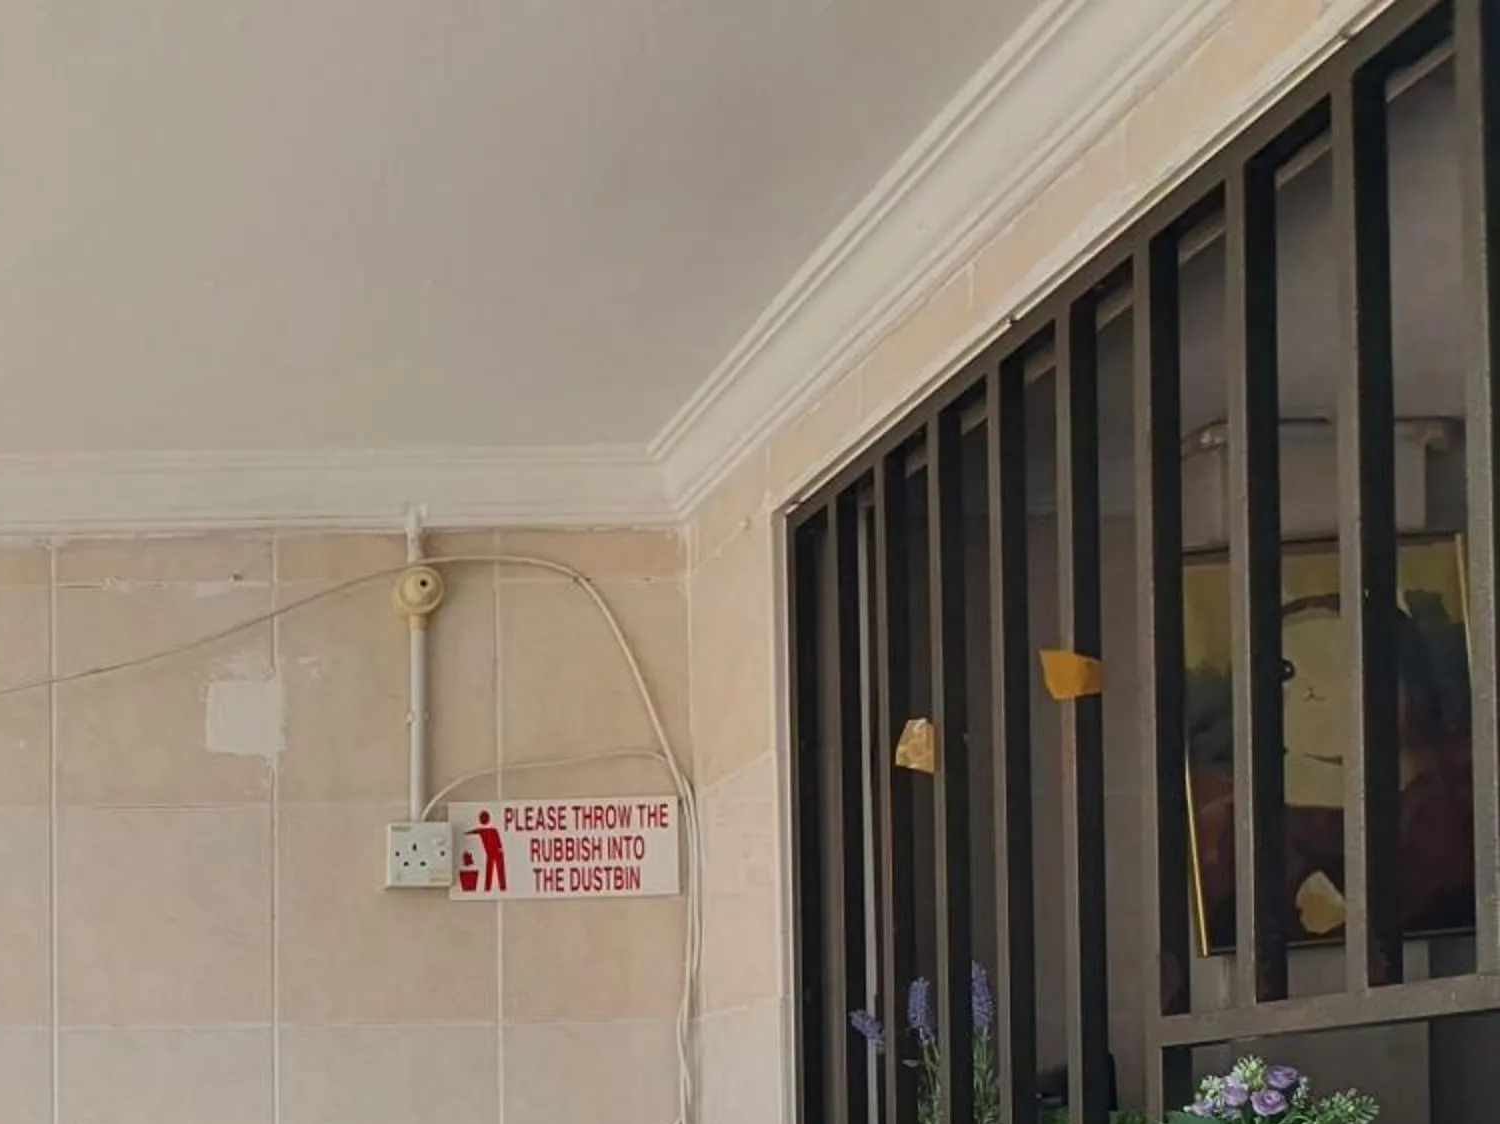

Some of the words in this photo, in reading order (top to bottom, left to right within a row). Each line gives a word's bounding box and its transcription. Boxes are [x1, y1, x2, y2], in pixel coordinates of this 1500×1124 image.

[504, 806, 567, 831] PLEASE
[573, 804, 634, 830] THROW
[637, 803, 669, 828] THE
[530, 837, 601, 862] RUBBISH
[608, 836, 645, 860] INTO
[533, 868, 564, 892] THE
[570, 867, 641, 891] DUSTBIN
